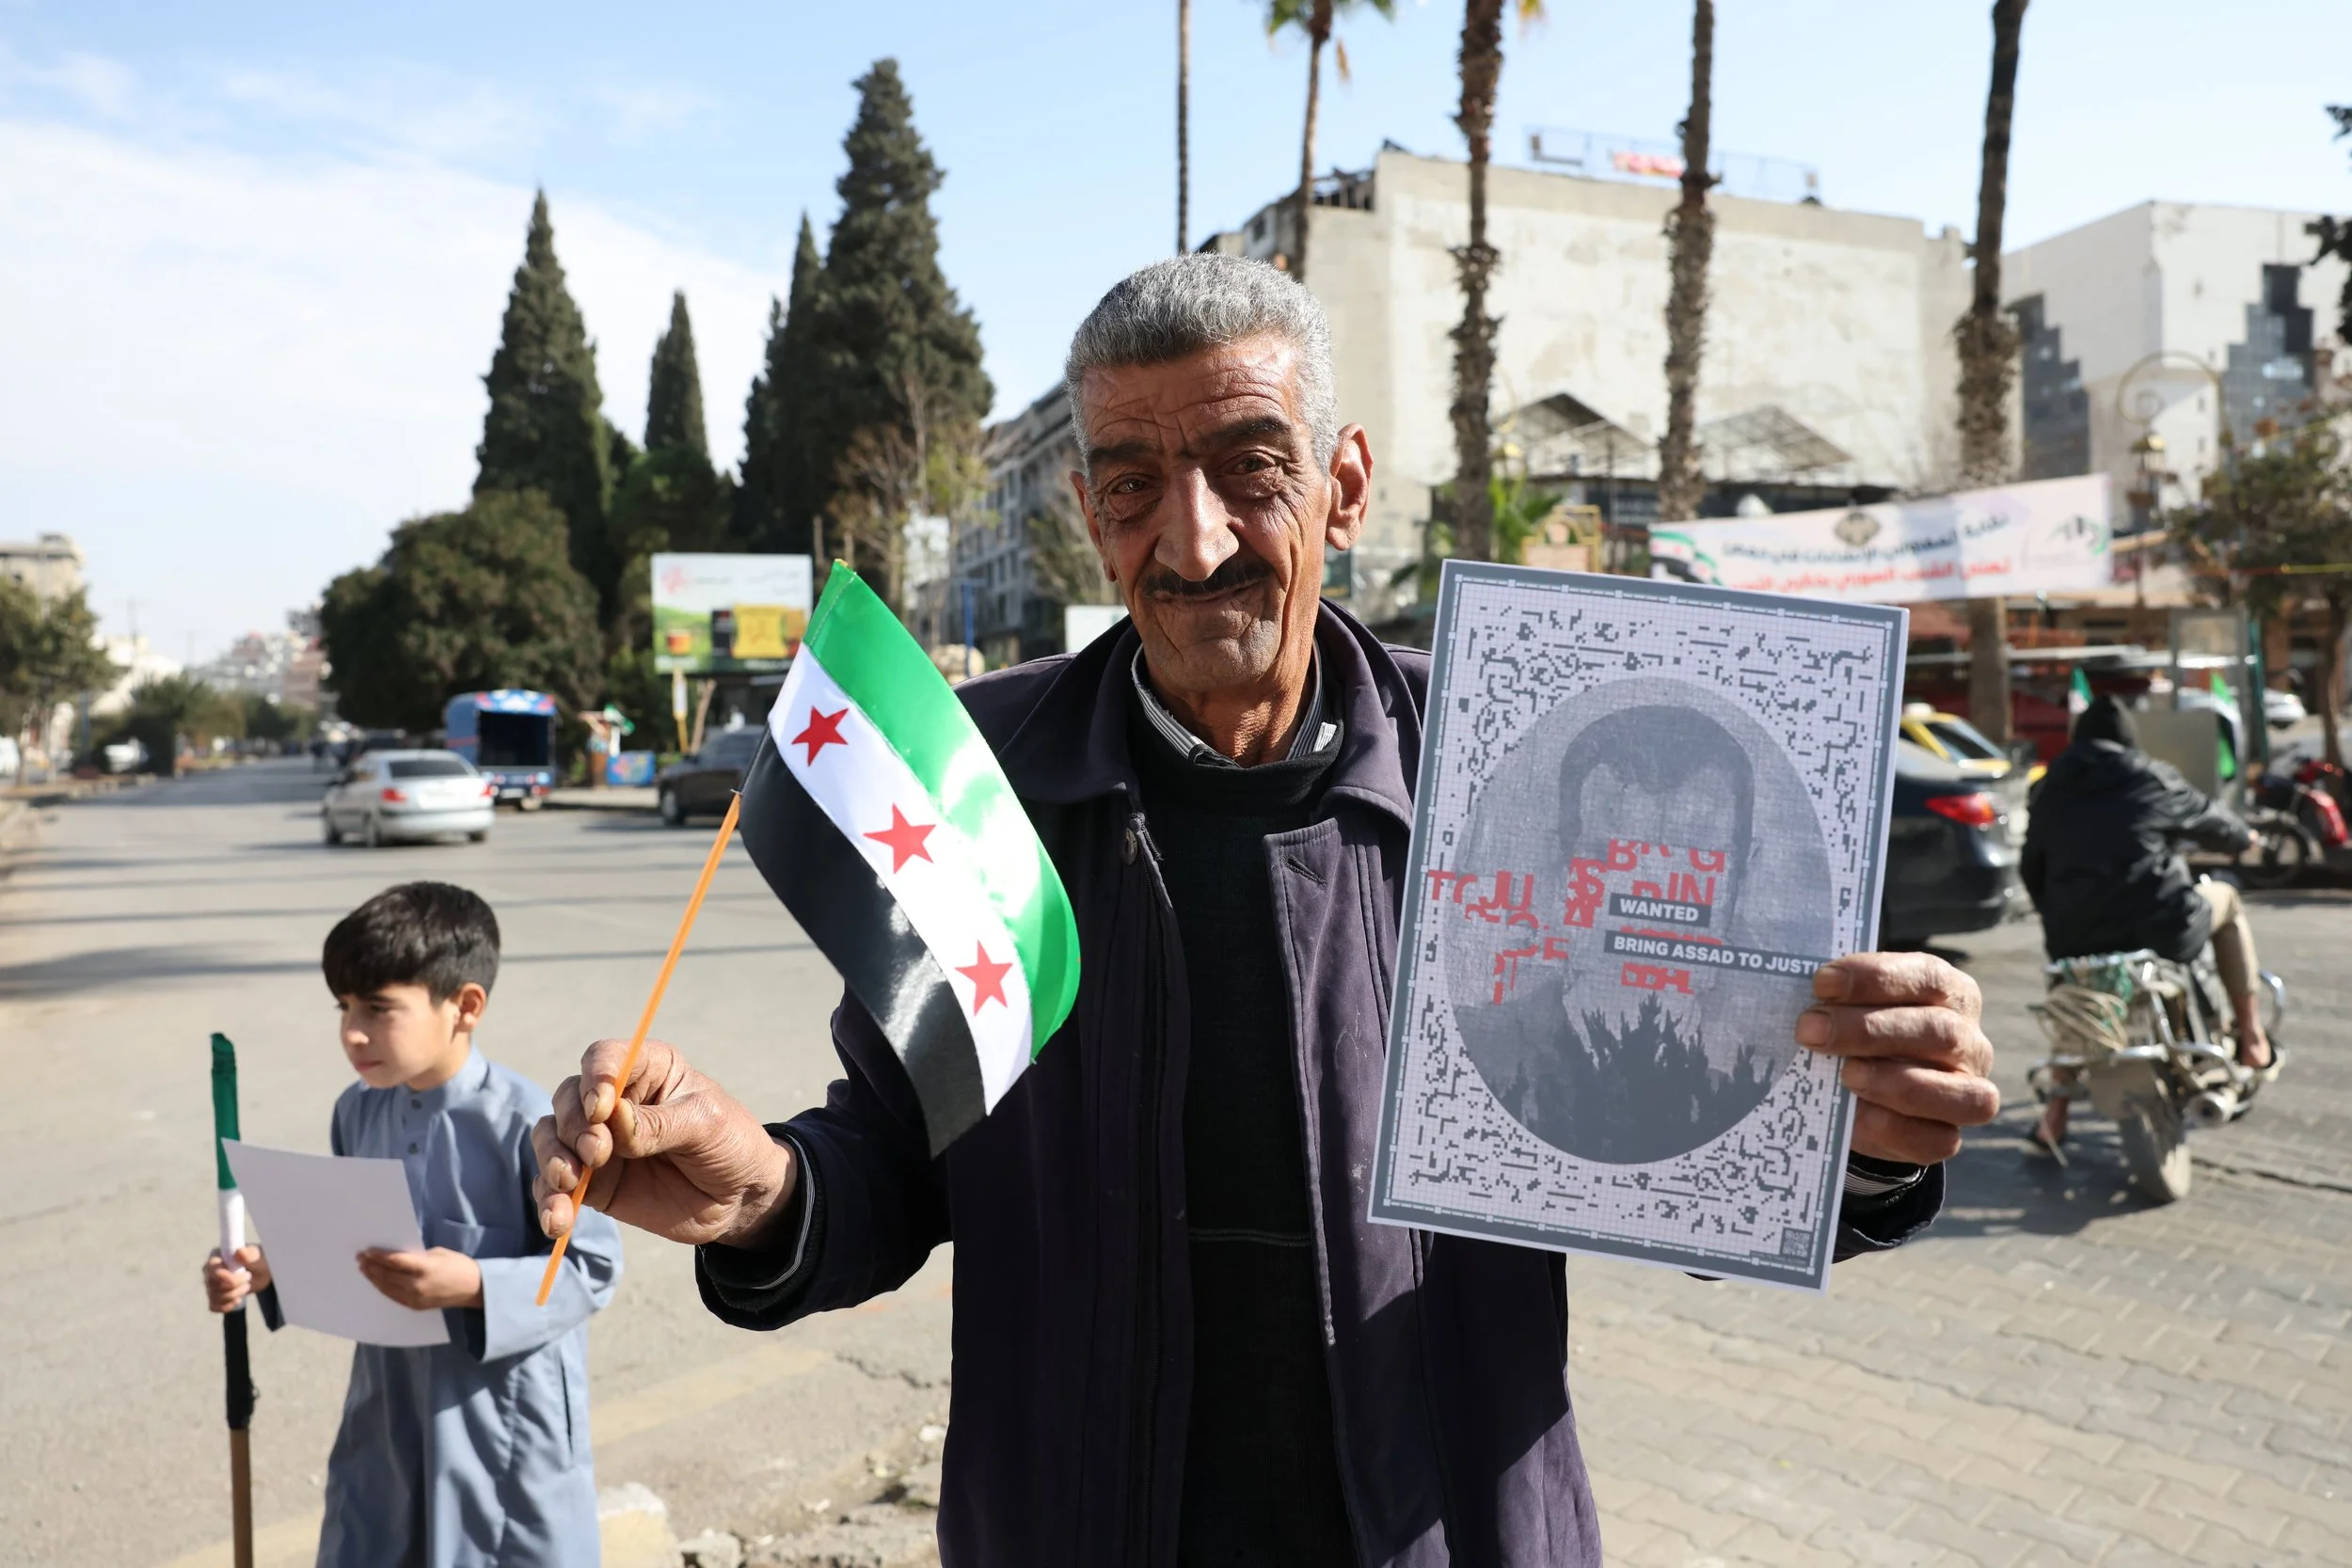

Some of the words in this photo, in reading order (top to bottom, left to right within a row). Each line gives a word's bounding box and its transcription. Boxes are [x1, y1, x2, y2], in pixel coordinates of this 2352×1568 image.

[1619, 897, 1699, 923] WANTED
[1613, 935, 1668, 956] BRING
[1671, 944, 1735, 965] ASSAD
[1739, 952, 1763, 969] TO
